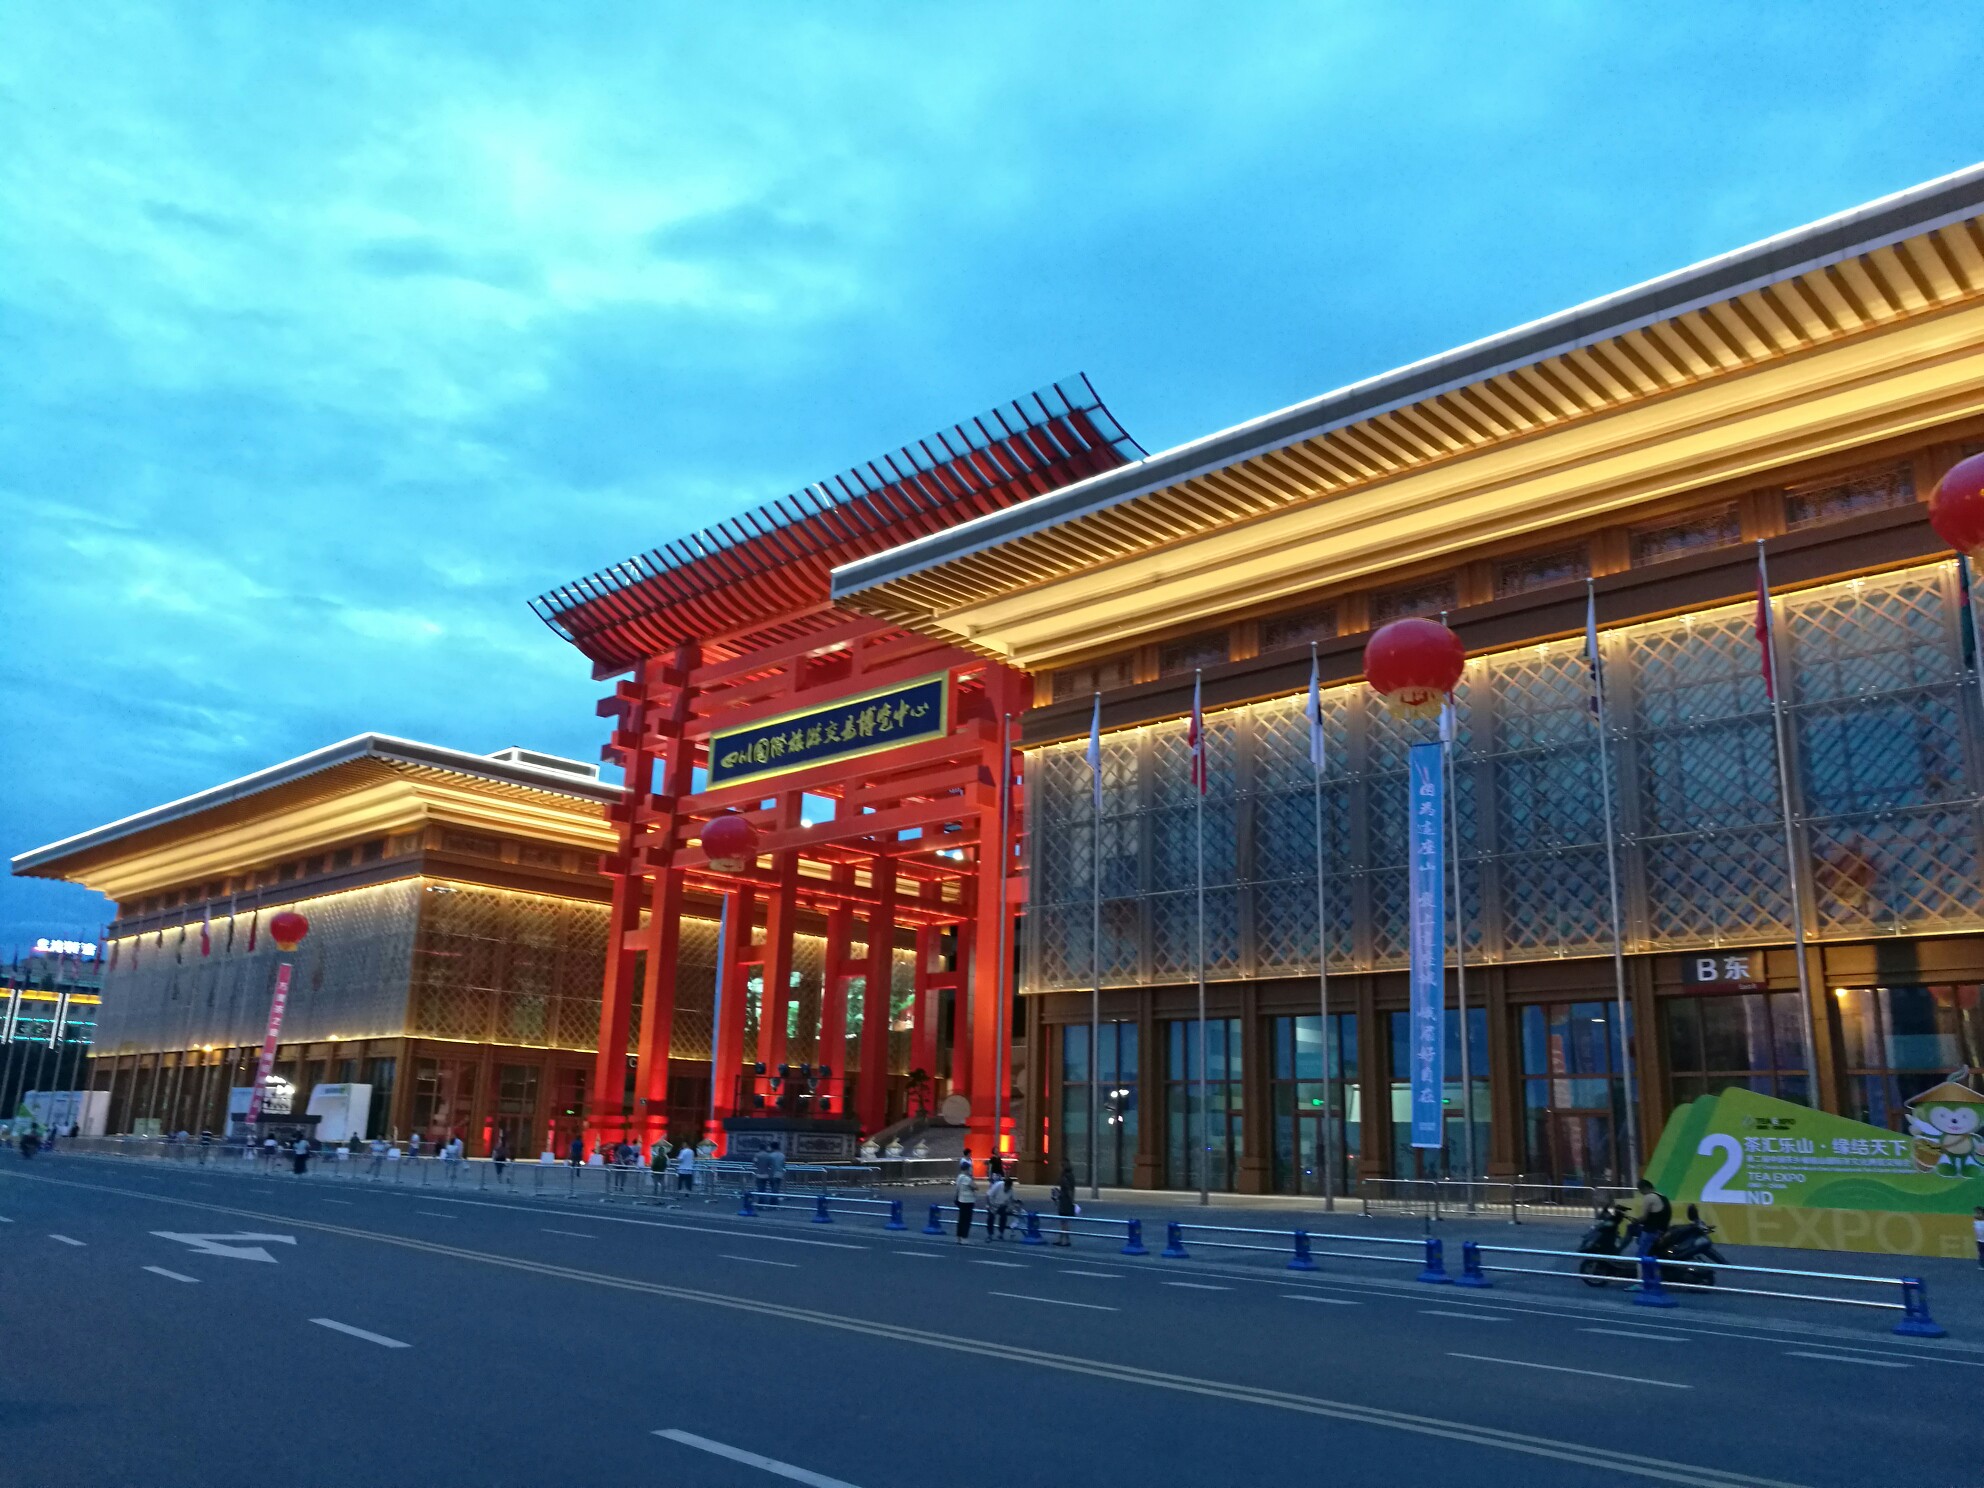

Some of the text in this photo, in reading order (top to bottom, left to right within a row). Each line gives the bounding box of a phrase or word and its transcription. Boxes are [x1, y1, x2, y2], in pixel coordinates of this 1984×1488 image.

[1697, 956, 1751, 981] B 东
[1697, 1133, 1746, 1204] 2
[1747, 1172, 1807, 1183] TEA EXPO
[1745, 1191, 1775, 1206] ND
[1747, 1205, 1923, 1255] EXPO
